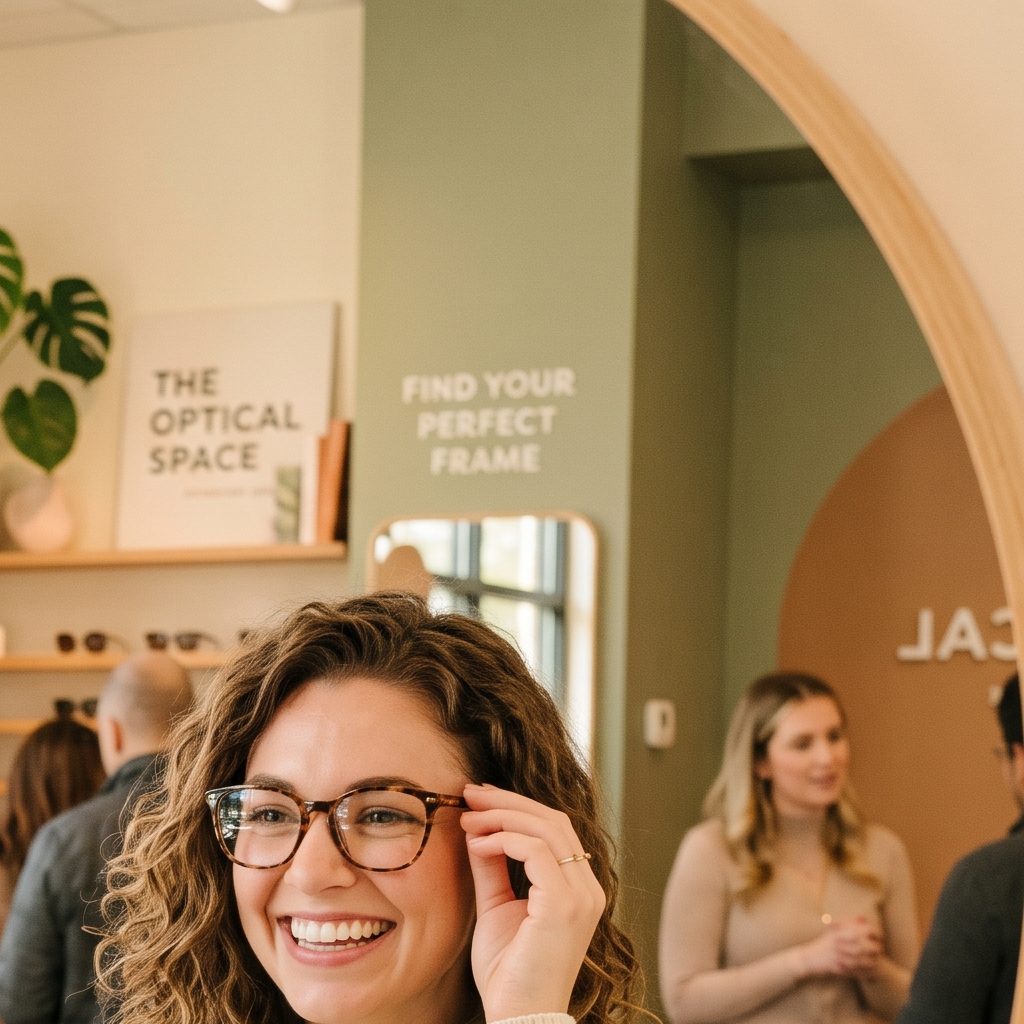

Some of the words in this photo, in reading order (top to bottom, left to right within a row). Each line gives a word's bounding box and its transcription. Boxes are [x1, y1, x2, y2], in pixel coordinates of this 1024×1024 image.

[154, 368, 218, 396] THE
[402, 373, 477, 403] FIND
[483, 367, 575, 399] YOUR
[150, 402, 300, 435] OPTICAL
[417, 406, 557, 439] PERFECT
[150, 442, 258, 474] SPACE
[430, 444, 540, 475] FRAME
